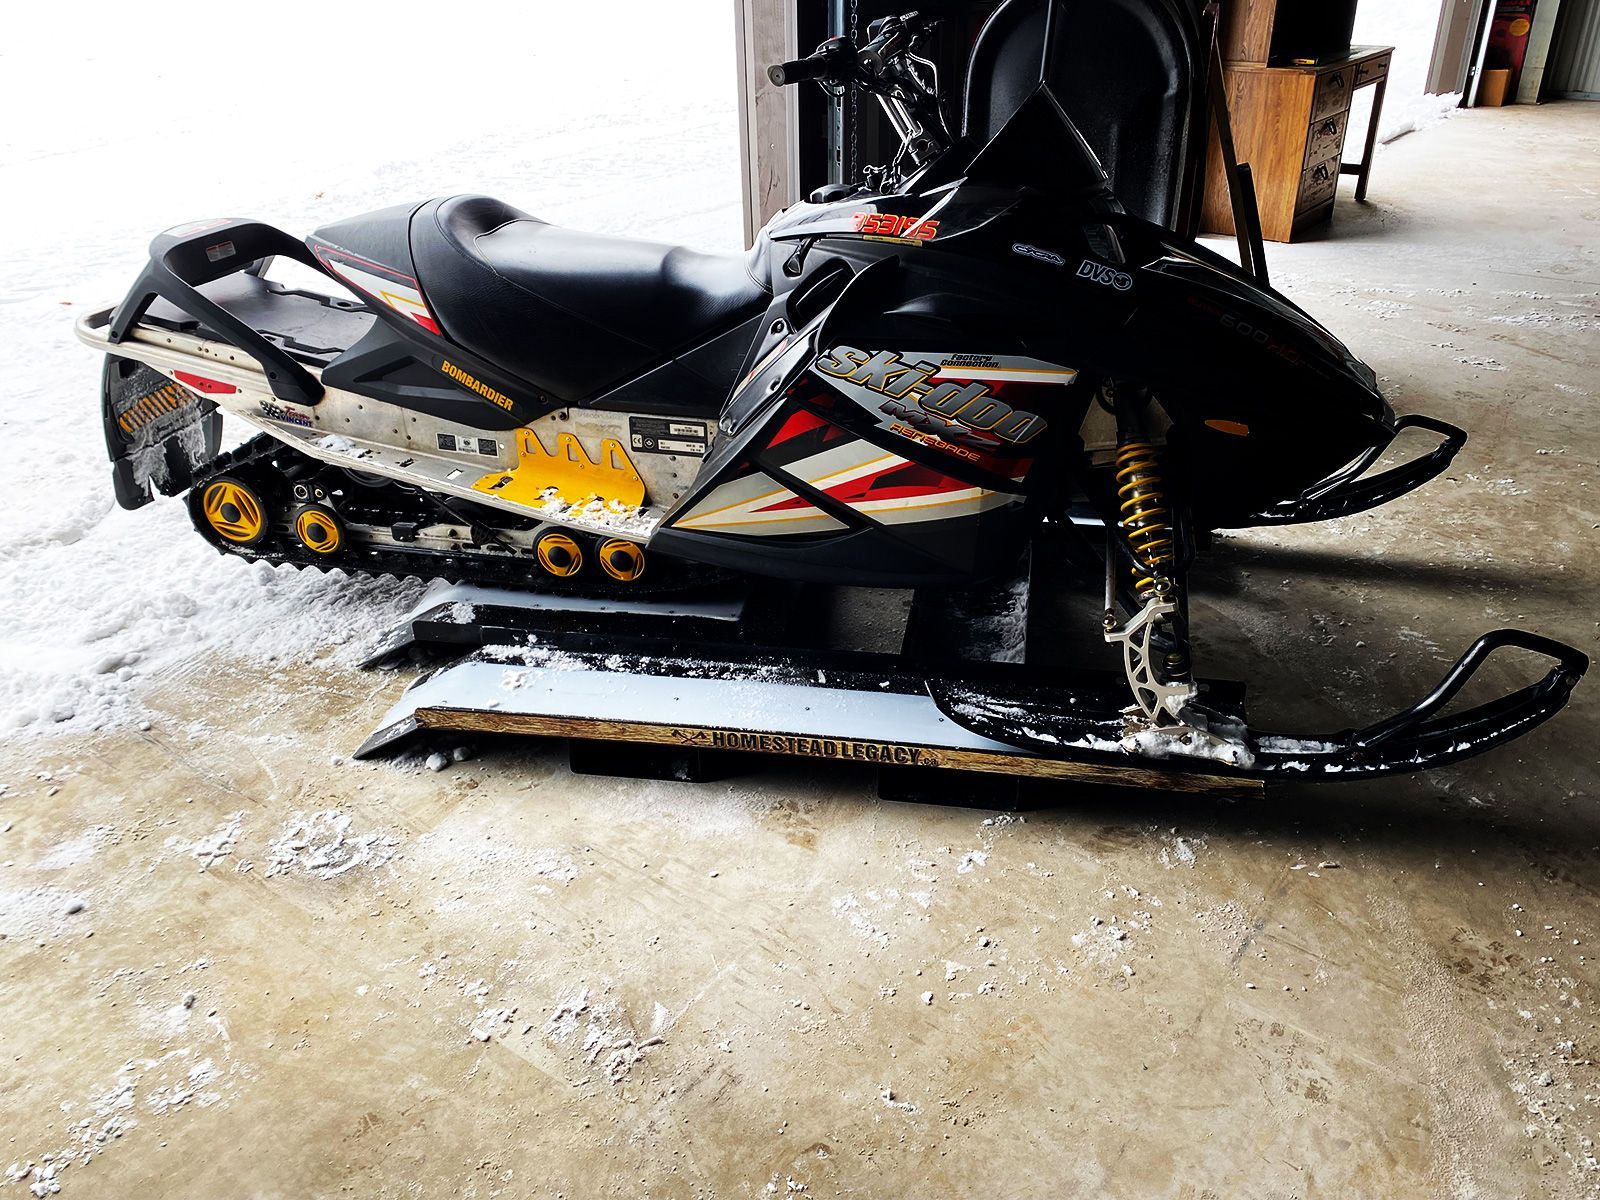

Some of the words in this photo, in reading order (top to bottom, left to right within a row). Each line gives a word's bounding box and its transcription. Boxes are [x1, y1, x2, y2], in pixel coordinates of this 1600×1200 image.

[1076, 259, 1118, 286] DVS
[440, 359, 515, 412] BOMBARDIER
[889, 422, 982, 462] RENEGADE
[711, 731, 839, 757] HOMESTEAD
